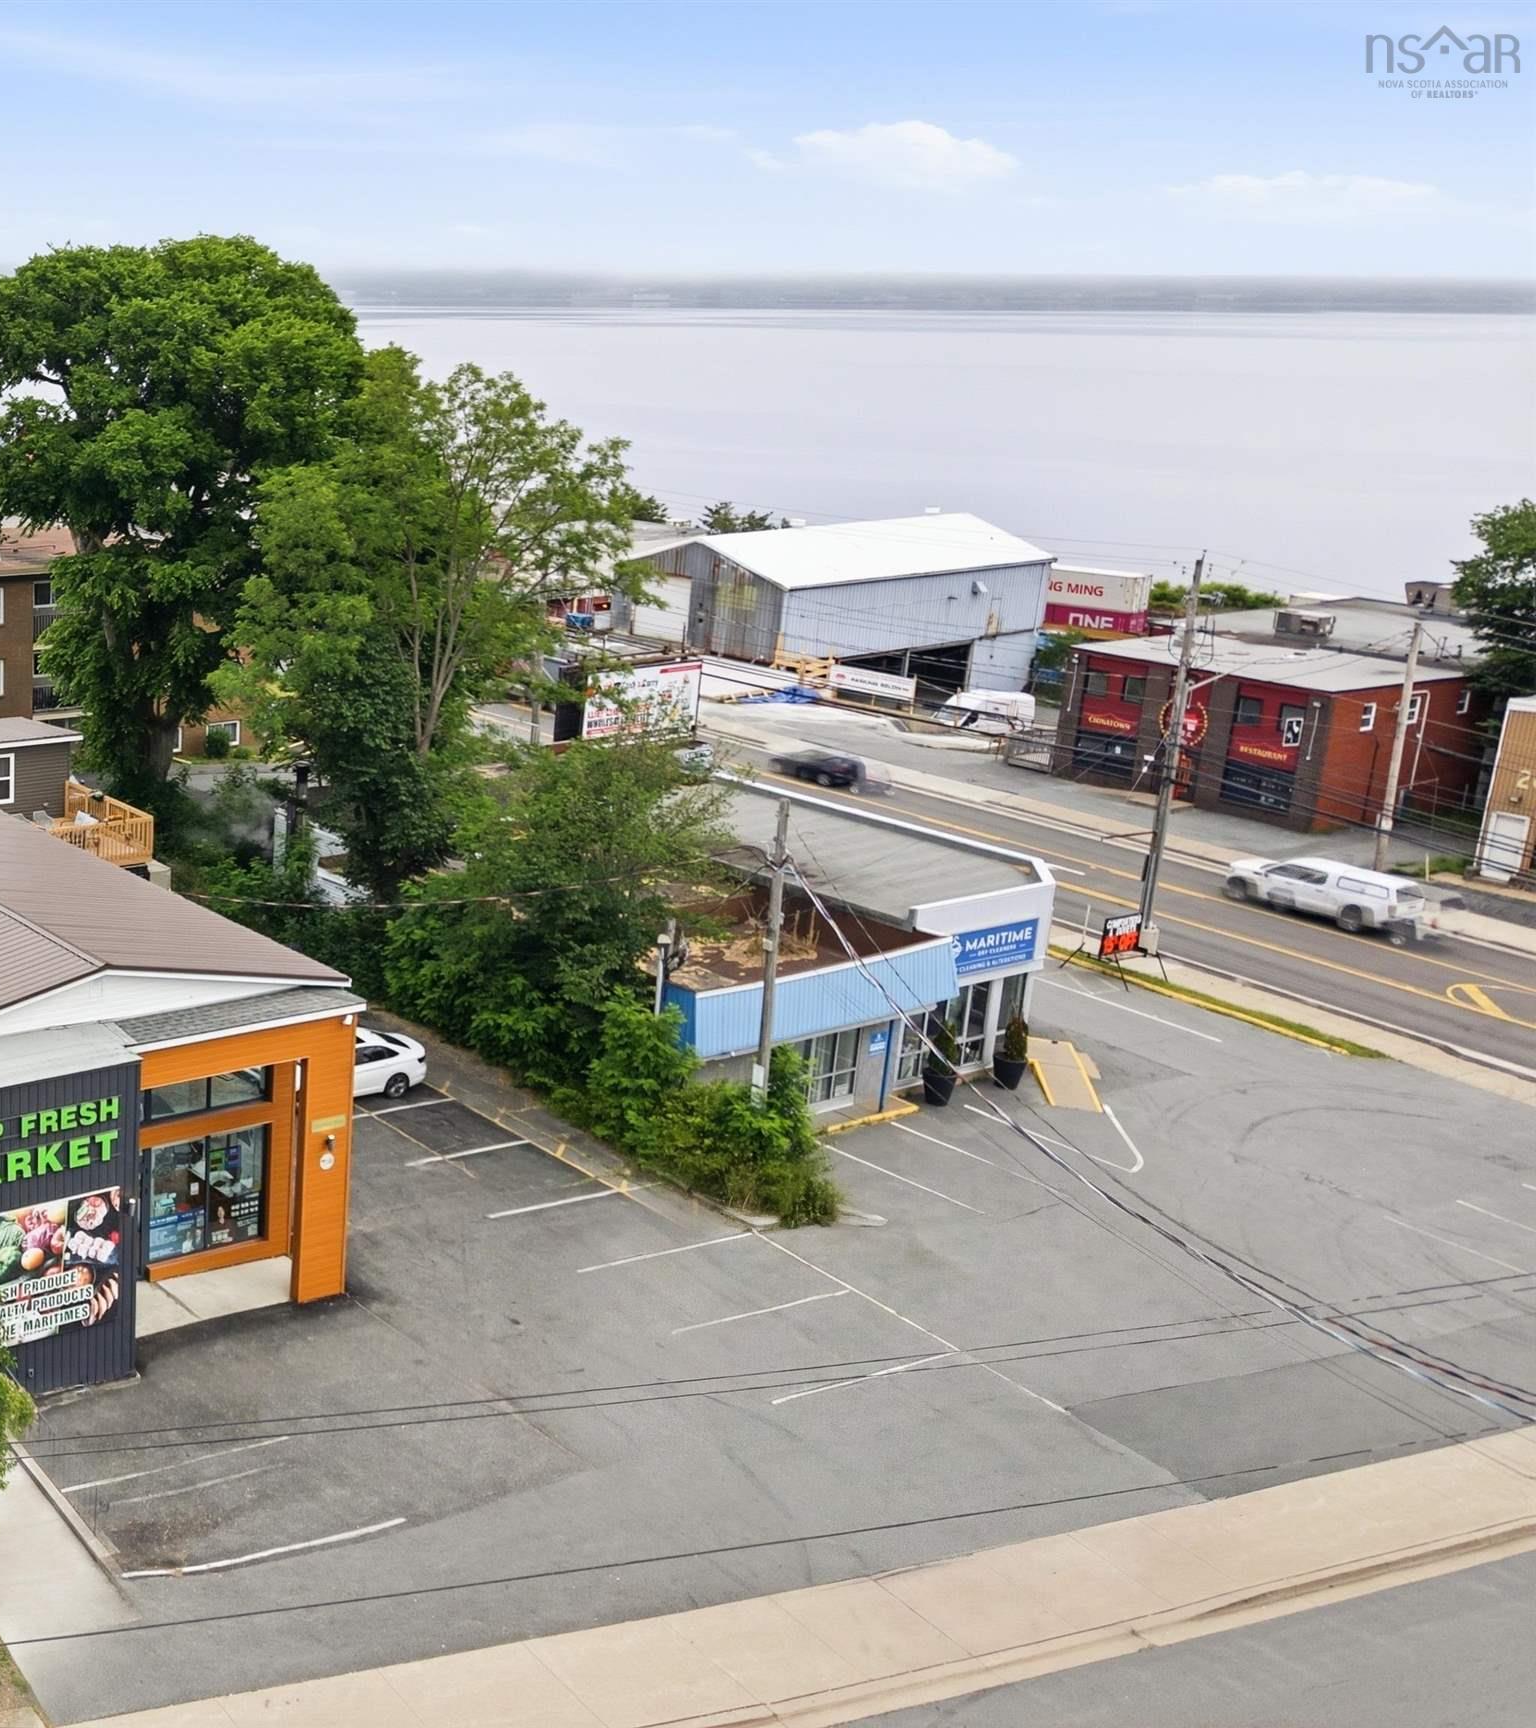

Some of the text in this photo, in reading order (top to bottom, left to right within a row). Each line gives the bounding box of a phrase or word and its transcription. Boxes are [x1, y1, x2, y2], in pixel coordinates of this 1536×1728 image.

[1067, 583, 1104, 597] MING
[1088, 716, 1131, 730] CHINATOWN
[1239, 745, 1288, 761] RESTAURANT
[965, 926, 1033, 952] MARITIME
[20, 1096, 120, 1139] FRESH
[23, 1271, 77, 1295] PRODUCE
[32, 1286, 94, 1312] PRODUCTS
[23, 1305, 89, 1332] MARITIMES
